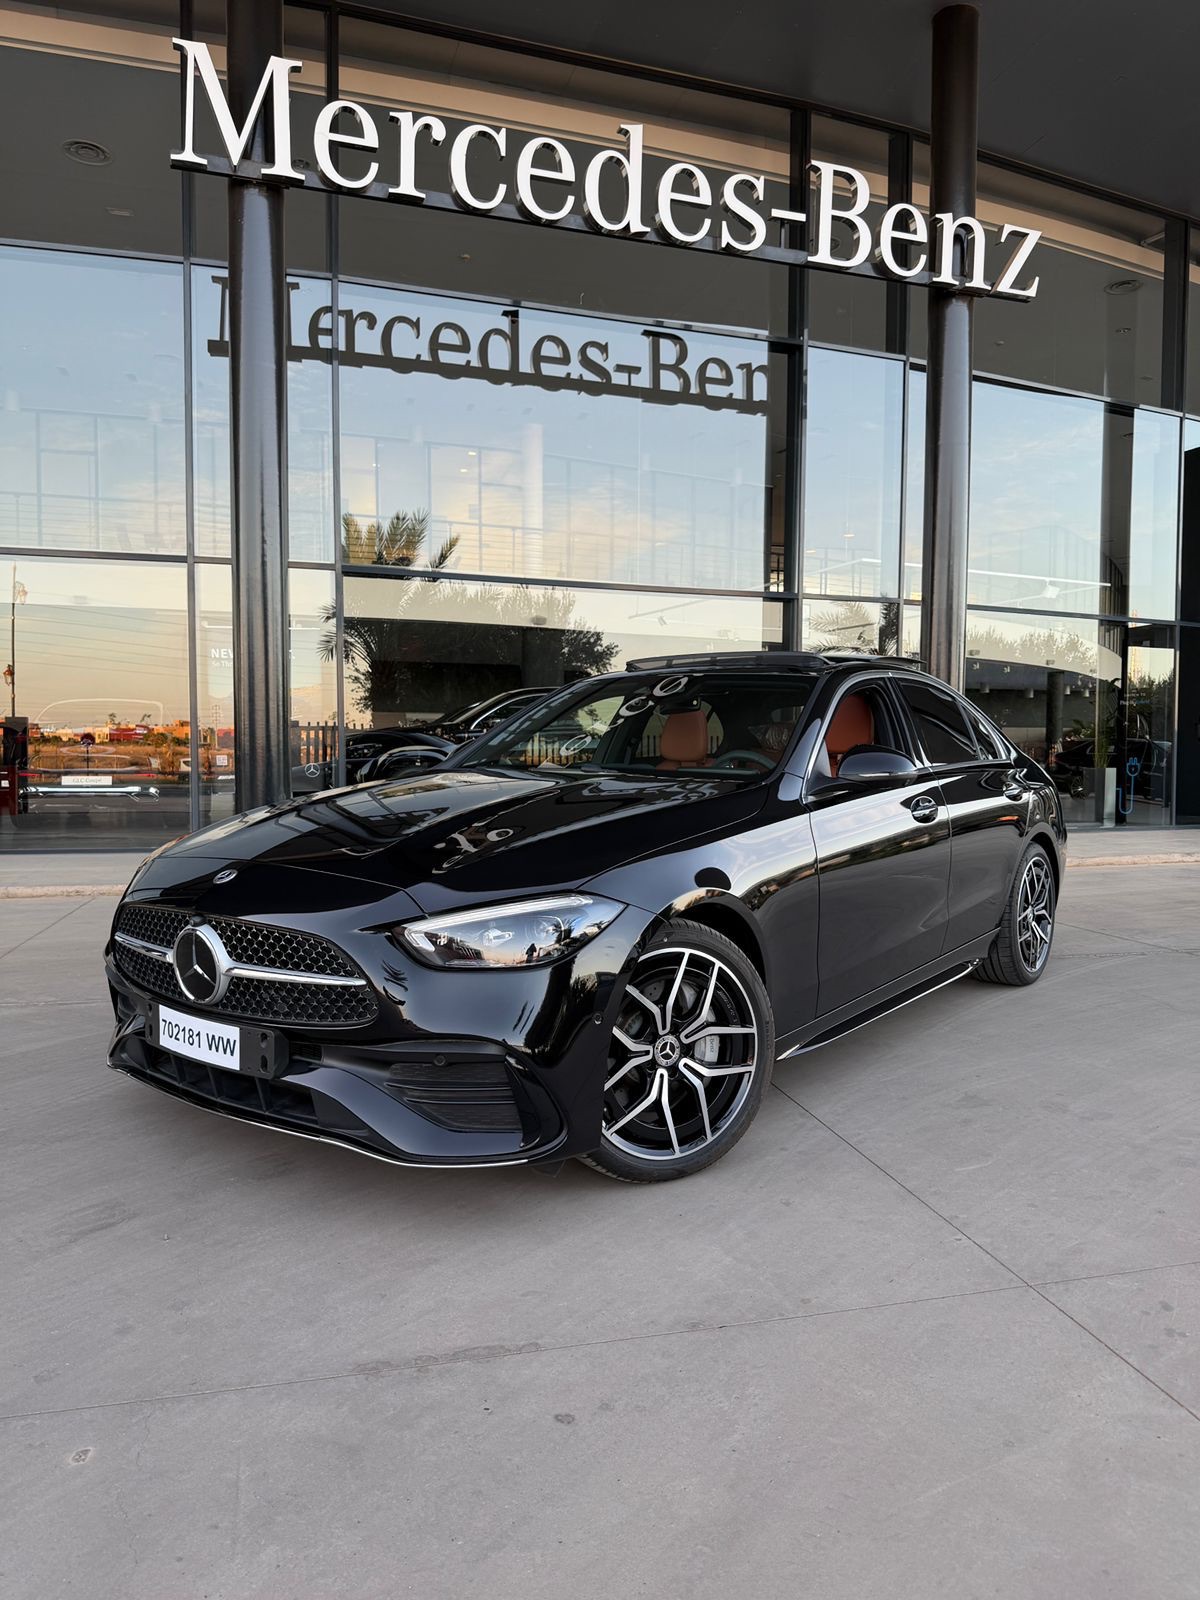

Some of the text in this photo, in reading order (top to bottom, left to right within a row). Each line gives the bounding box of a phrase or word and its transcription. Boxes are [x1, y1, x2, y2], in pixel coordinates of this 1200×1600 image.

[171, 37, 1042, 299] Mercedes-Benz
[162, 1018, 237, 1057] 702181 WW
